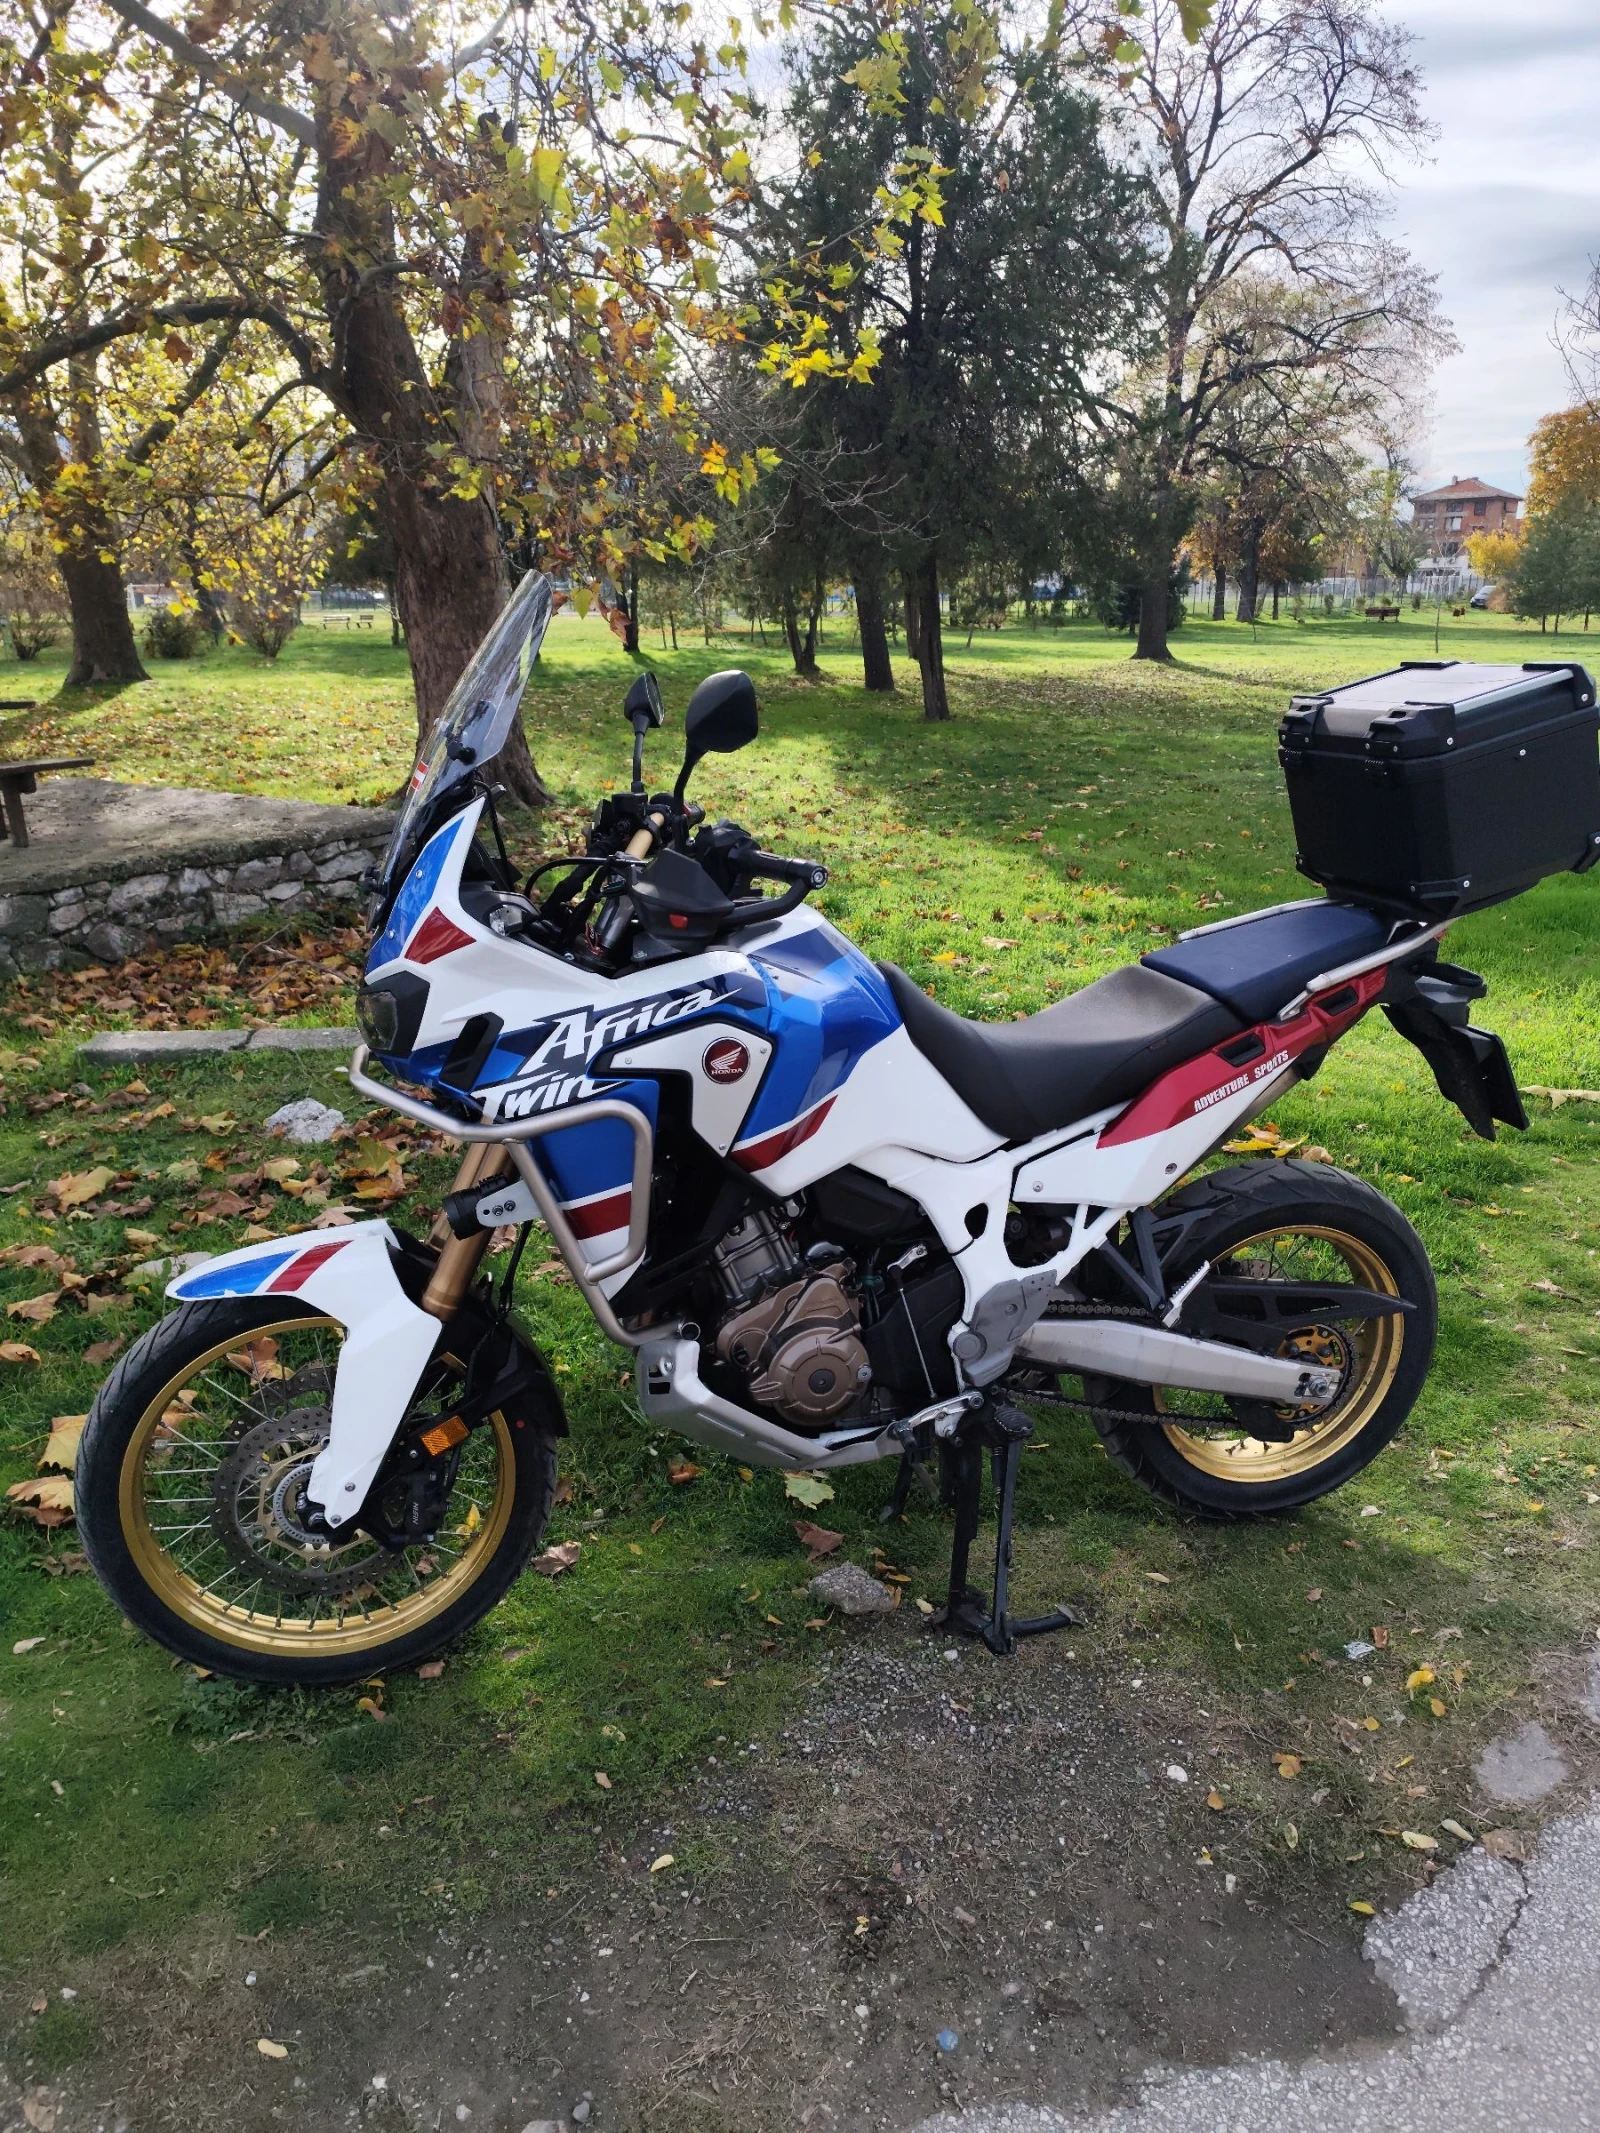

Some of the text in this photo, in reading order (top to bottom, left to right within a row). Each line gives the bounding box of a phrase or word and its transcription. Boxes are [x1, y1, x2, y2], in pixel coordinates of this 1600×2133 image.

[517, 987, 743, 1076] Africa
[470, 1069, 626, 1124] Twin
[711, 1067, 744, 1075] HONDA
[1194, 1050, 1289, 1112] ADVENTURE SPORTS
